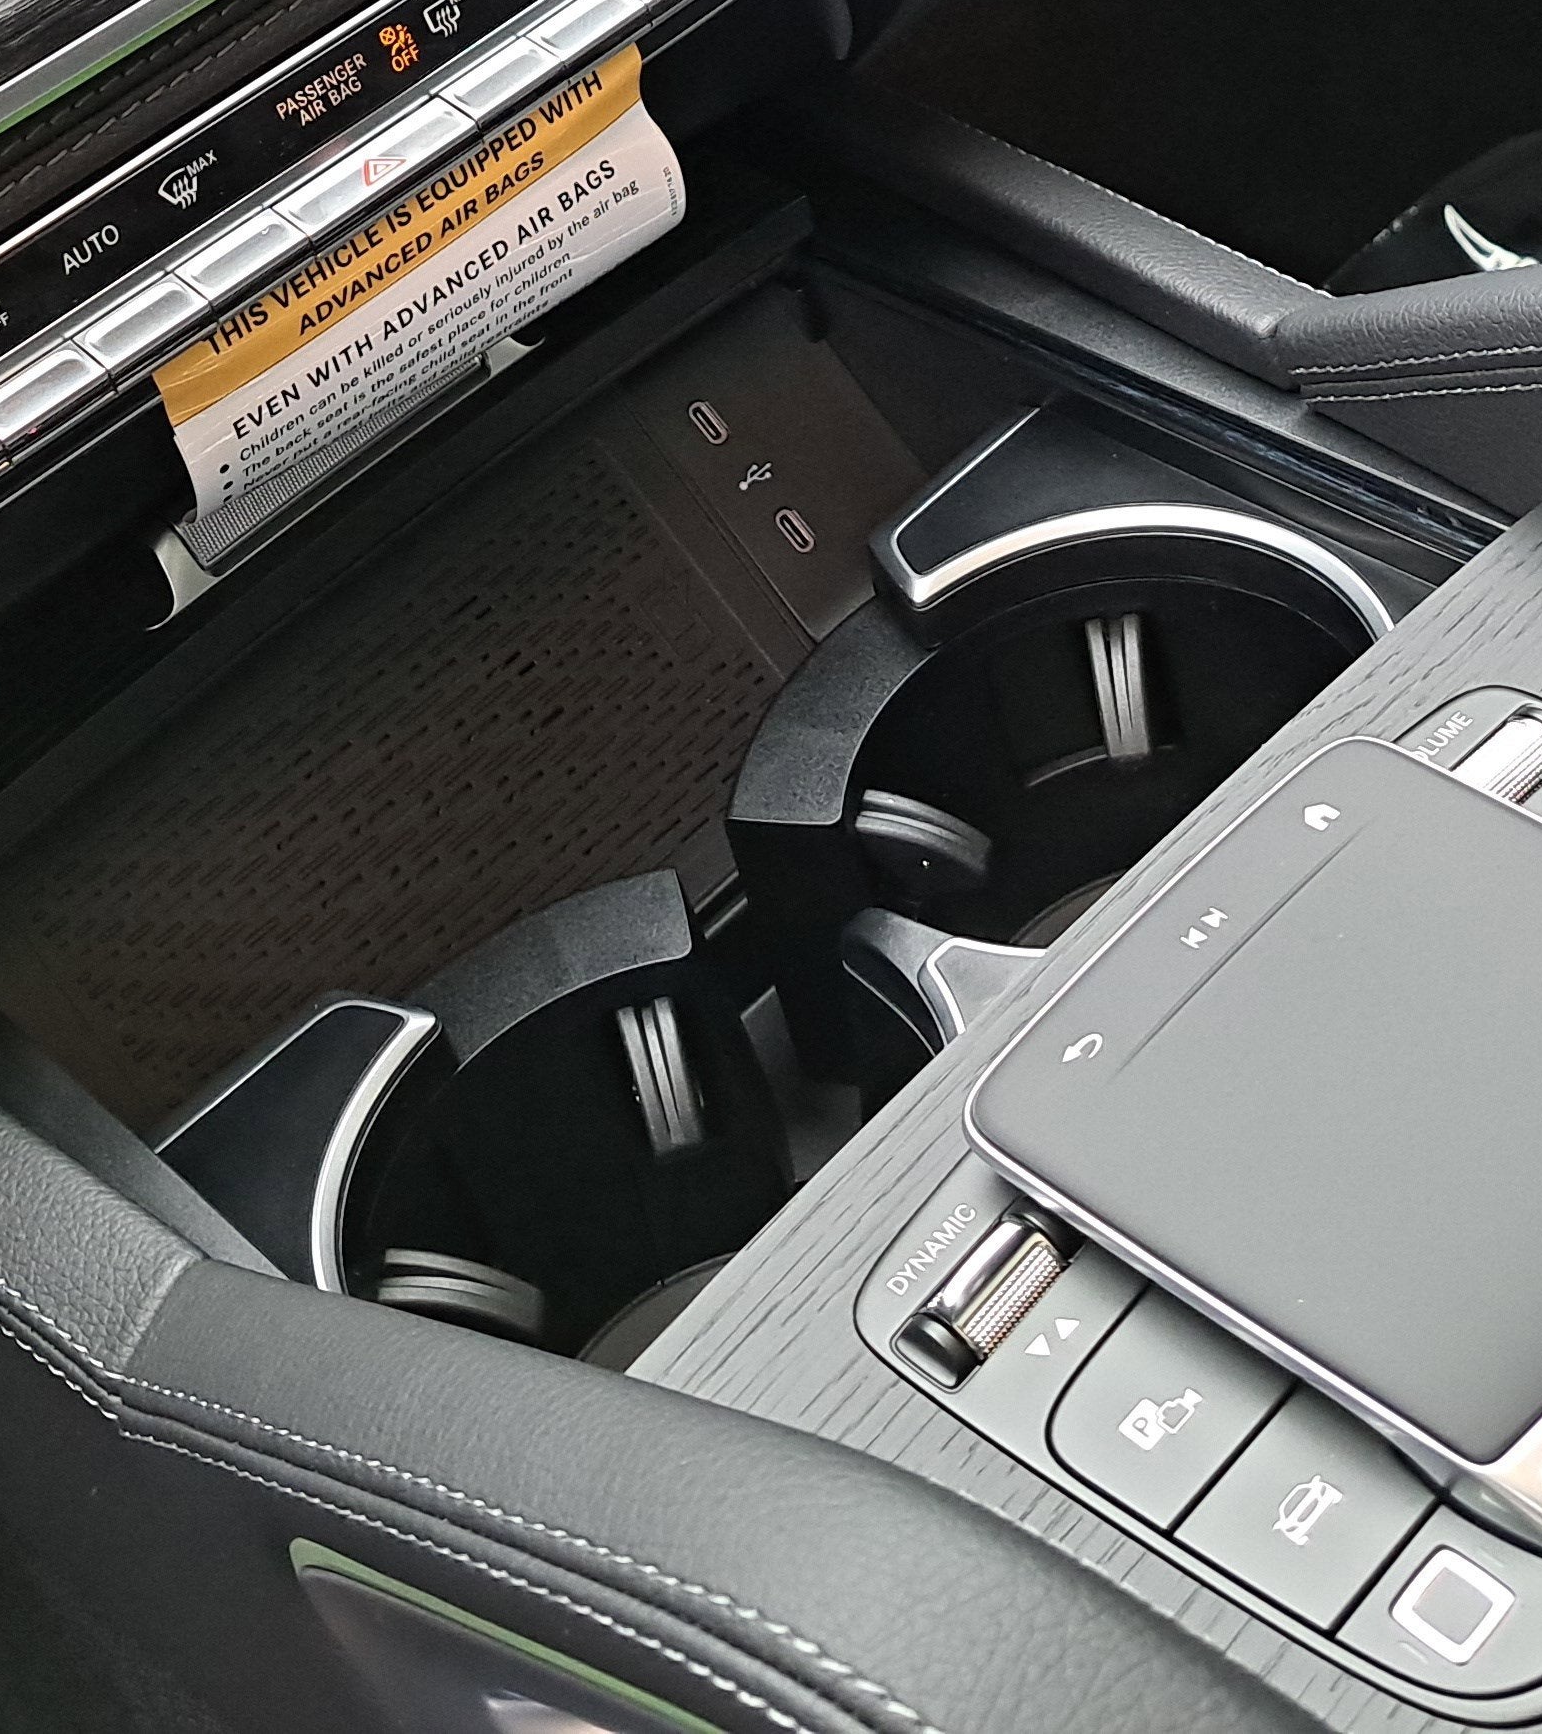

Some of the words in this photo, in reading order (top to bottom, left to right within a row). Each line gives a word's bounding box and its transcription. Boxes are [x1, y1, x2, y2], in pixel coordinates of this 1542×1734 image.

[276, 53, 367, 120] PASSENGER
[299, 100, 327, 127] AIR
[330, 76, 363, 106] BAG
[392, 44, 421, 72] OFF
[186, 149, 218, 178] MAX
[63, 225, 120, 276] AUTO
[203, 302, 269, 355] THIS
[270, 225, 384, 309] VEHICLE
[385, 202, 412, 235] IS
[415, 117, 537, 213] EQUIPPED
[539, 70, 603, 125] WITH
[299, 232, 433, 337] ADVANCED
[440, 198, 479, 239] AIR
[484, 151, 545, 205] BAGS
[232, 383, 301, 440] EVEN
[307, 333, 374, 388] WITH
[383, 239, 509, 341] ADVANCED
[516, 206, 554, 246] AIR
[557, 159, 615, 213] BAGS
[240, 414, 305, 461] Children
[309, 392, 337, 415] can
[340, 376, 359, 394] be
[363, 343, 404, 378] killed
[408, 330, 424, 348] or
[427, 283, 492, 335] seriously
[495, 245, 545, 288] injured
[547, 232, 565, 251] by
[567, 215, 590, 237] the
[593, 199, 610, 219] air
[612, 180, 639, 205] bag
[421, 345, 456, 375] child
[461, 323, 490, 348] seat
[495, 313, 508, 326] in
[513, 295, 536, 313] the
[540, 268, 574, 298] front
[242, 456, 270, 477] The
[275, 427, 312, 456] back
[317, 402, 348, 428] seat
[353, 392, 366, 405] is
[371, 372, 394, 393] the
[399, 338, 443, 373] safest
[448, 310, 486, 343] place
[490, 293, 510, 312] for
[514, 252, 571, 296] children
[1411, 711, 1473, 762] OLUME
[886, 1203, 977, 1297] DYNAMIC
